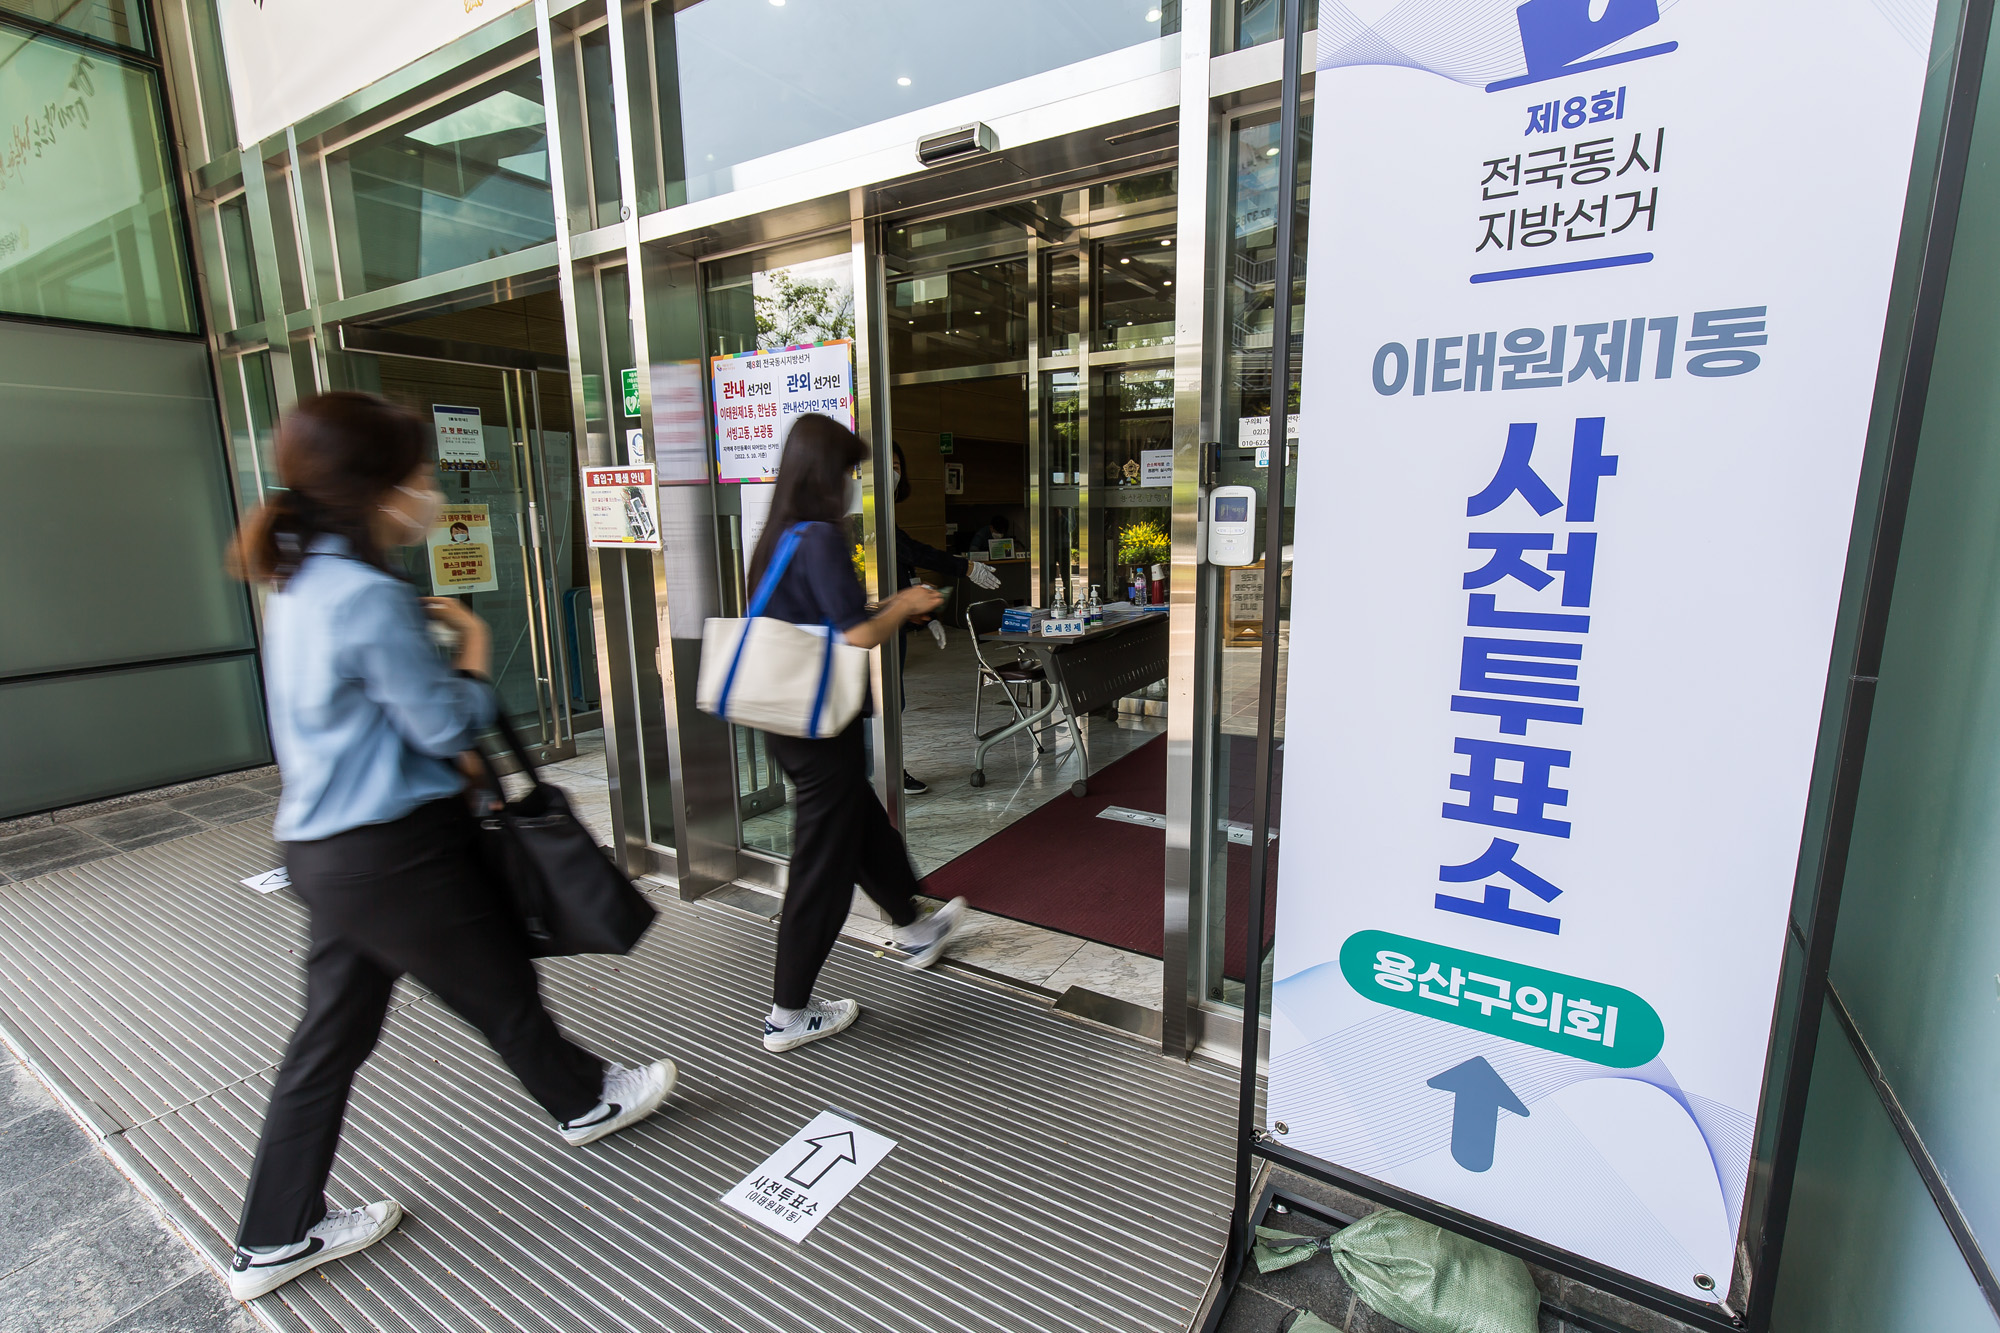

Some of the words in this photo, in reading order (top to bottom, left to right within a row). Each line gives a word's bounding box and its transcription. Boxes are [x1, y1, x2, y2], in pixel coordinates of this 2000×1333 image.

[1525, 86, 1626, 136] 제8회
[1480, 127, 1665, 201] 전국동시
[1475, 187, 1658, 253] 지방선거
[1372, 305, 1769, 396] 이태원제1동
[746, 359, 761, 369] 제8회
[762, 353, 810, 368] 전국동시지방선거
[723, 379, 746, 399] 관내
[747, 382, 772, 396] 선거인
[787, 372, 811, 393] 관외
[813, 374, 841, 390] 선거인
[720, 404, 757, 420] 이태원제1동,
[757, 402, 778, 418] 한남동
[782, 400, 820, 415] 관내선거인
[821, 397, 838, 411] 지역
[839, 397, 848, 409] 외
[726, 425, 753, 441] 서빙고동,
[753, 424, 774, 439] 보광동
[440, 458, 499, 472] 용산구의회
[593, 473, 614, 485] 출입구
[614, 472, 629, 484] 폐쇄
[630, 471, 645, 484] 안내
[1044, 622, 1082, 633] 손세정제
[1434, 416, 1619, 936] 사전투표소
[1373, 949, 1619, 1048] 용산구의회
[806, 1016, 823, 1031] N
[749, 1175, 820, 1217] 사전투표소
[745, 1190, 803, 1224] (이태원제1동)
